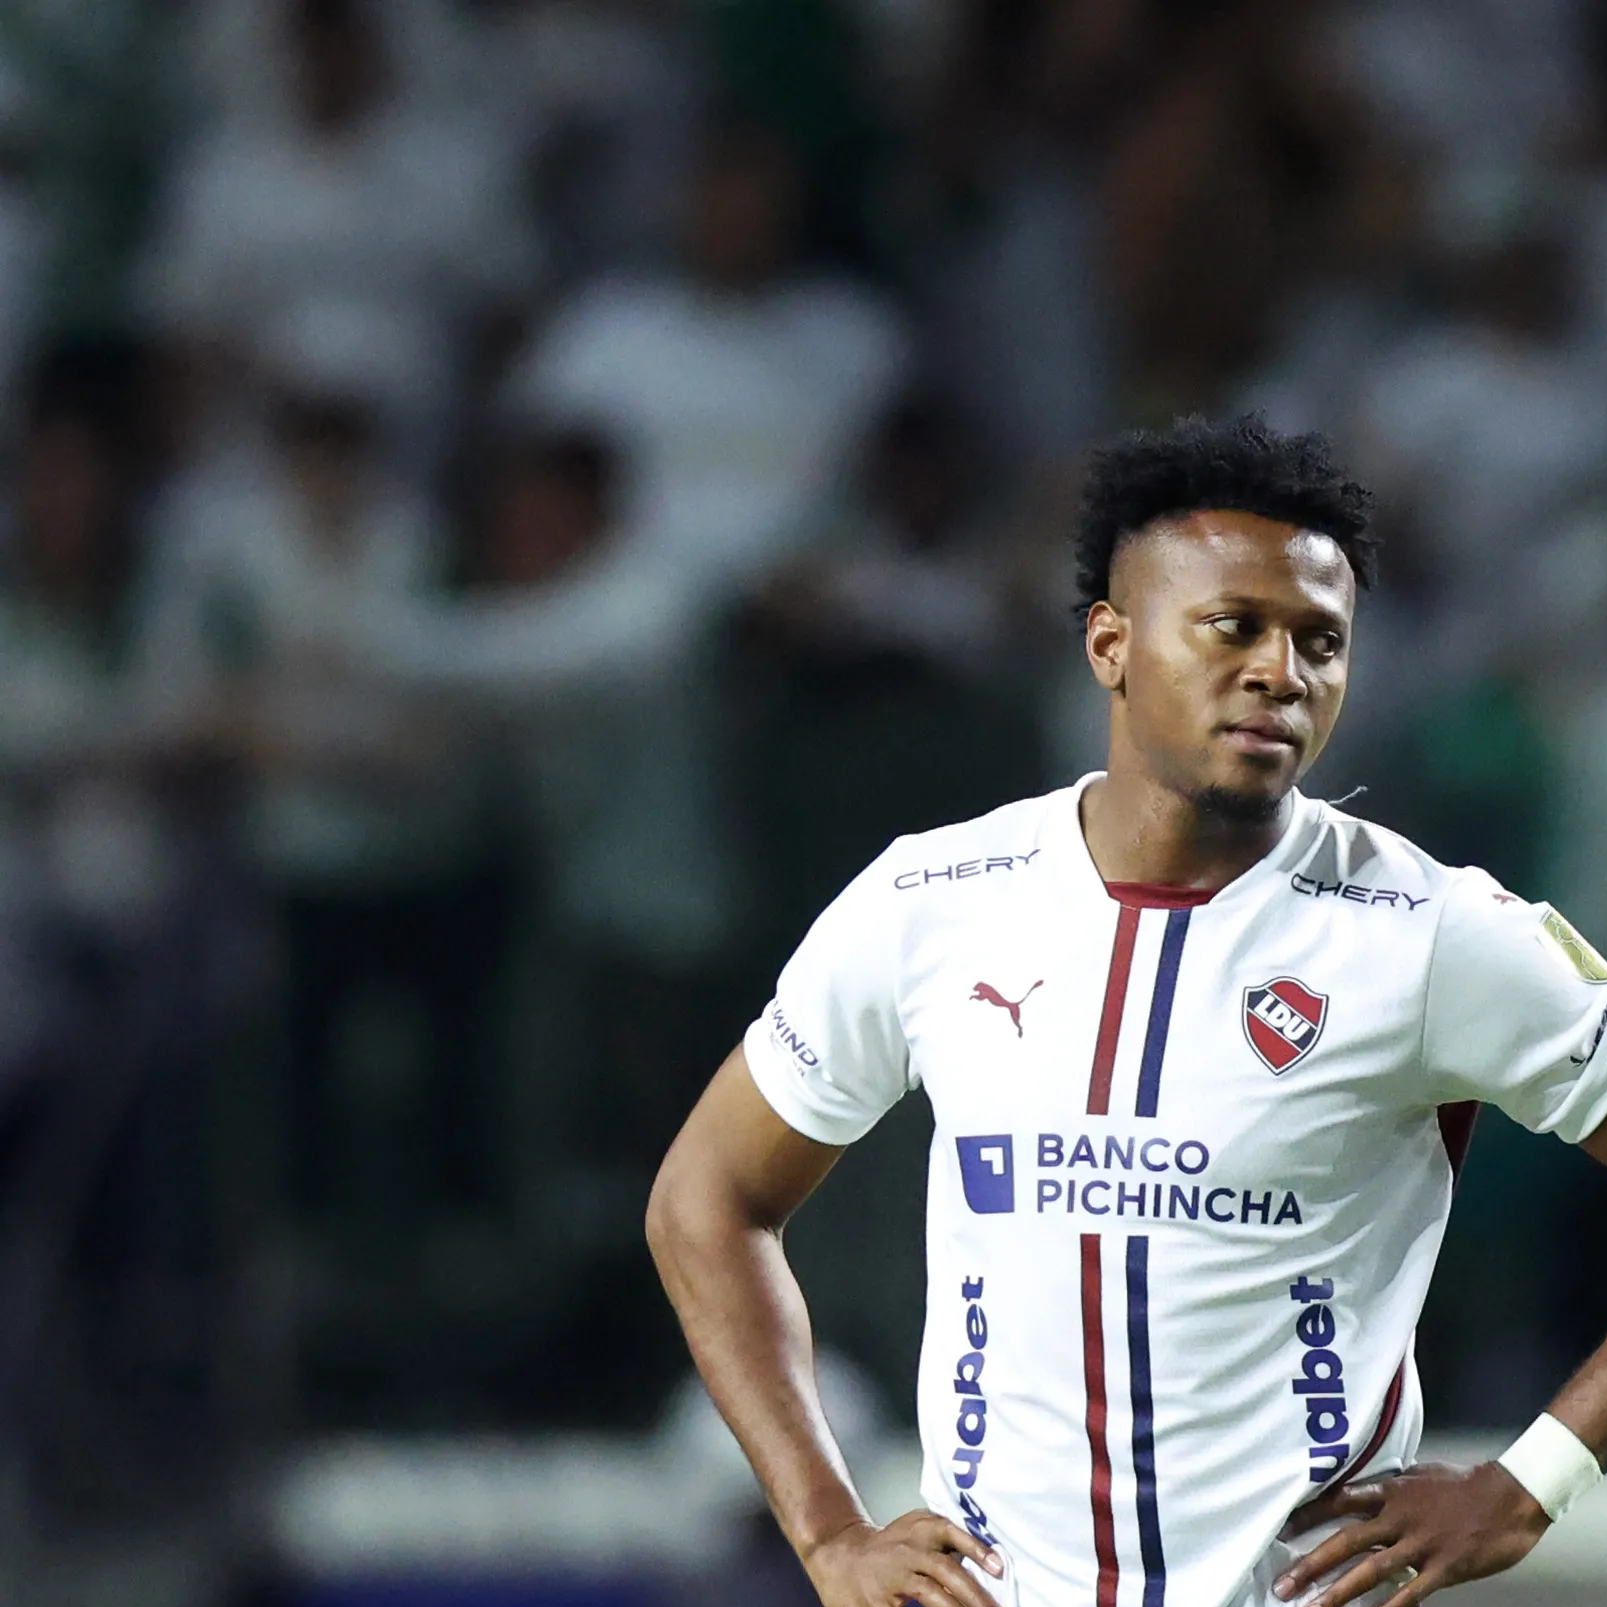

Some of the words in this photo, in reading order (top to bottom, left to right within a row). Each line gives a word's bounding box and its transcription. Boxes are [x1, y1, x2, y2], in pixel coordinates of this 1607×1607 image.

[894, 849, 1041, 890] CHERY
[1291, 873, 1430, 911] CHERY
[1253, 993, 1311, 1041] LDU
[1037, 1133, 1209, 1175] BANCO
[1036, 1179, 1303, 1226] PICHINCHA
